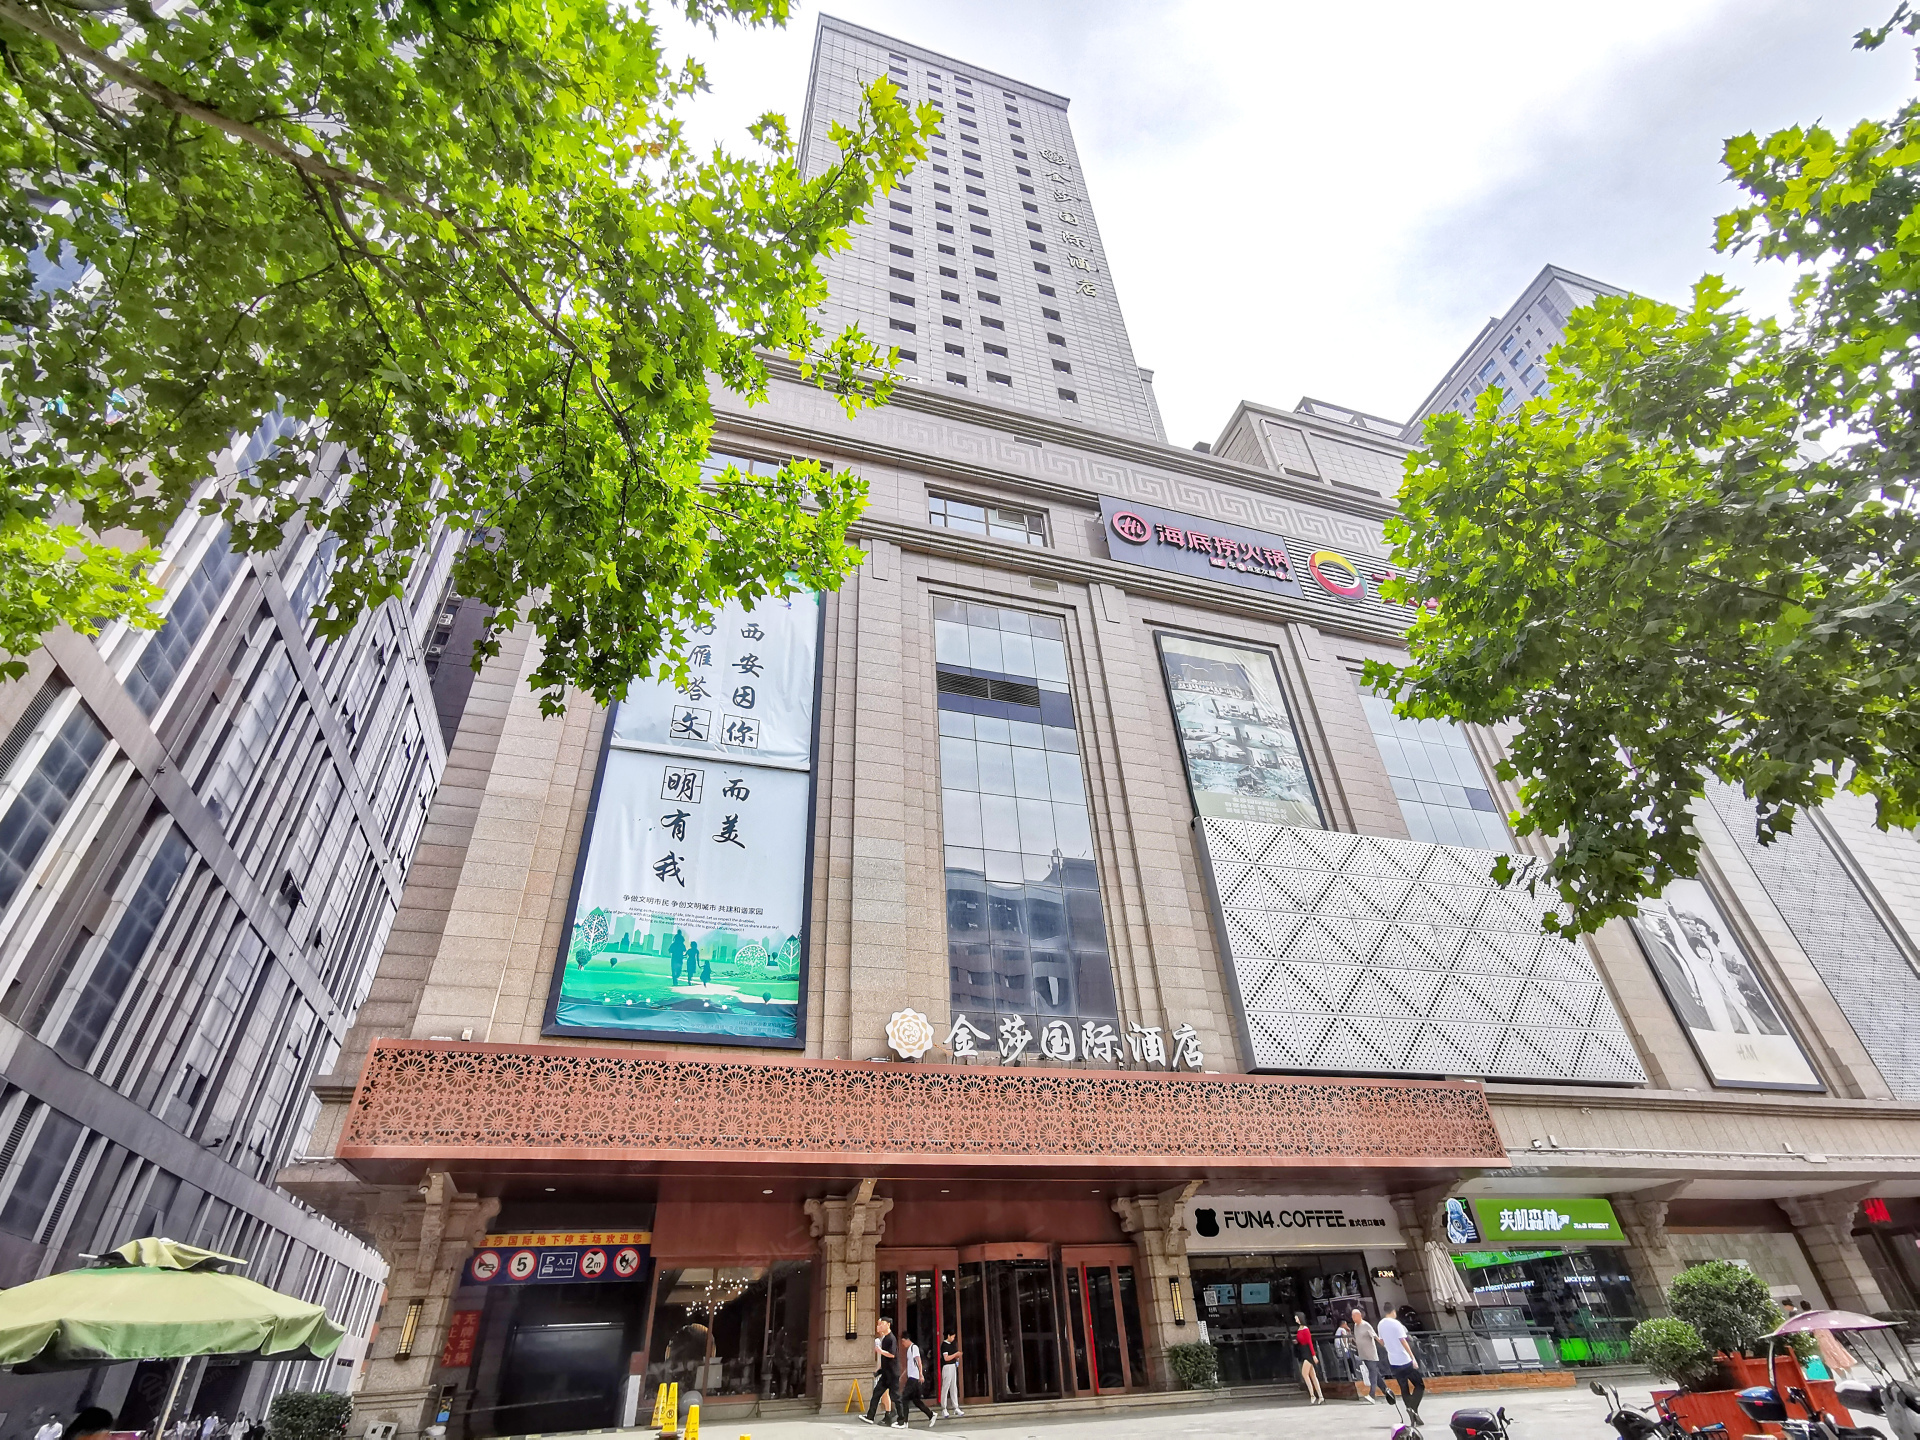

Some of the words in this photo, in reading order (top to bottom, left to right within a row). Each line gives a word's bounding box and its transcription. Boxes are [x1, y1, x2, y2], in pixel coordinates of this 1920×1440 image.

[1155, 523, 1290, 571] 海底捞火锅
[943, 1013, 1205, 1069] 金莎国际酒店
[1499, 1208, 1562, 1232] 夹机森林
[478, 1233, 643, 1247] 金莎国际地下停车场欢迎您
[516, 1256, 528, 1272] 5
[556, 1257, 574, 1266] 入口
[585, 1256, 602, 1269] 2m
